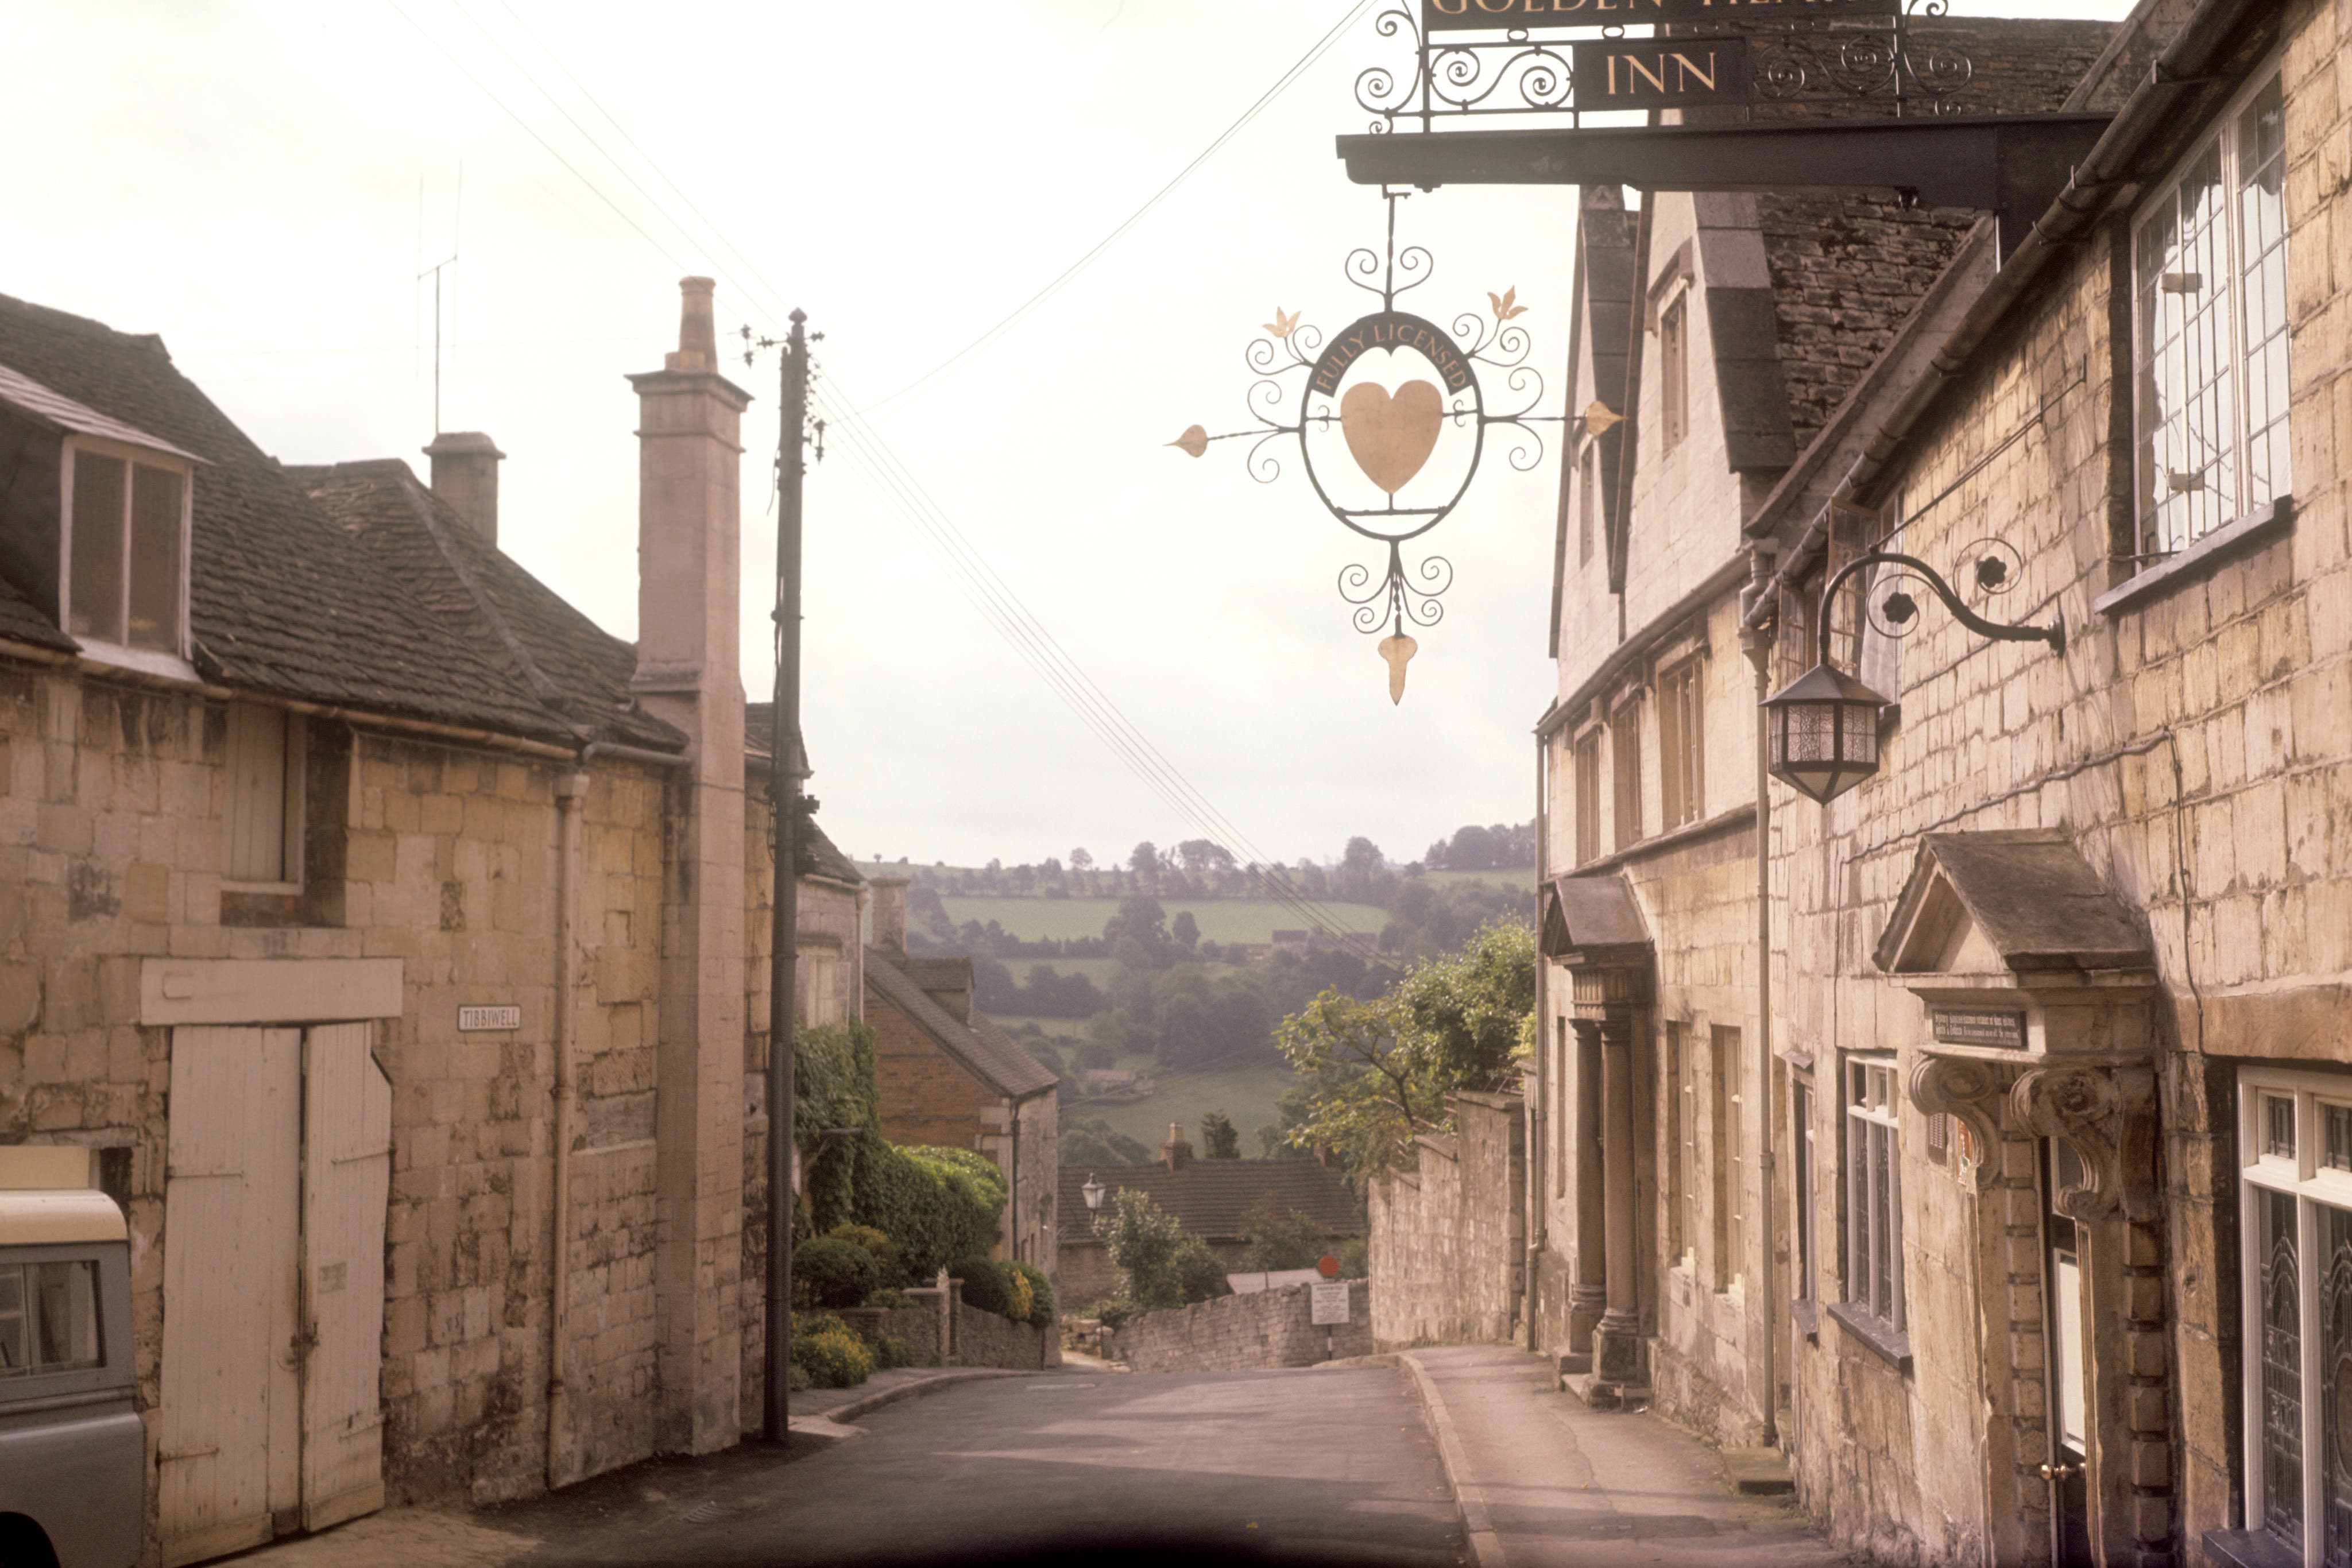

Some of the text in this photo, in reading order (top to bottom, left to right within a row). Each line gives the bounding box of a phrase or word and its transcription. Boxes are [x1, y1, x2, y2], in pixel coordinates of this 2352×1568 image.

[1607, 52, 1715, 94] INN
[1316, 323, 1467, 390] FULLY LICENSED
[463, 1009, 517, 1027] TIBBIWELL
